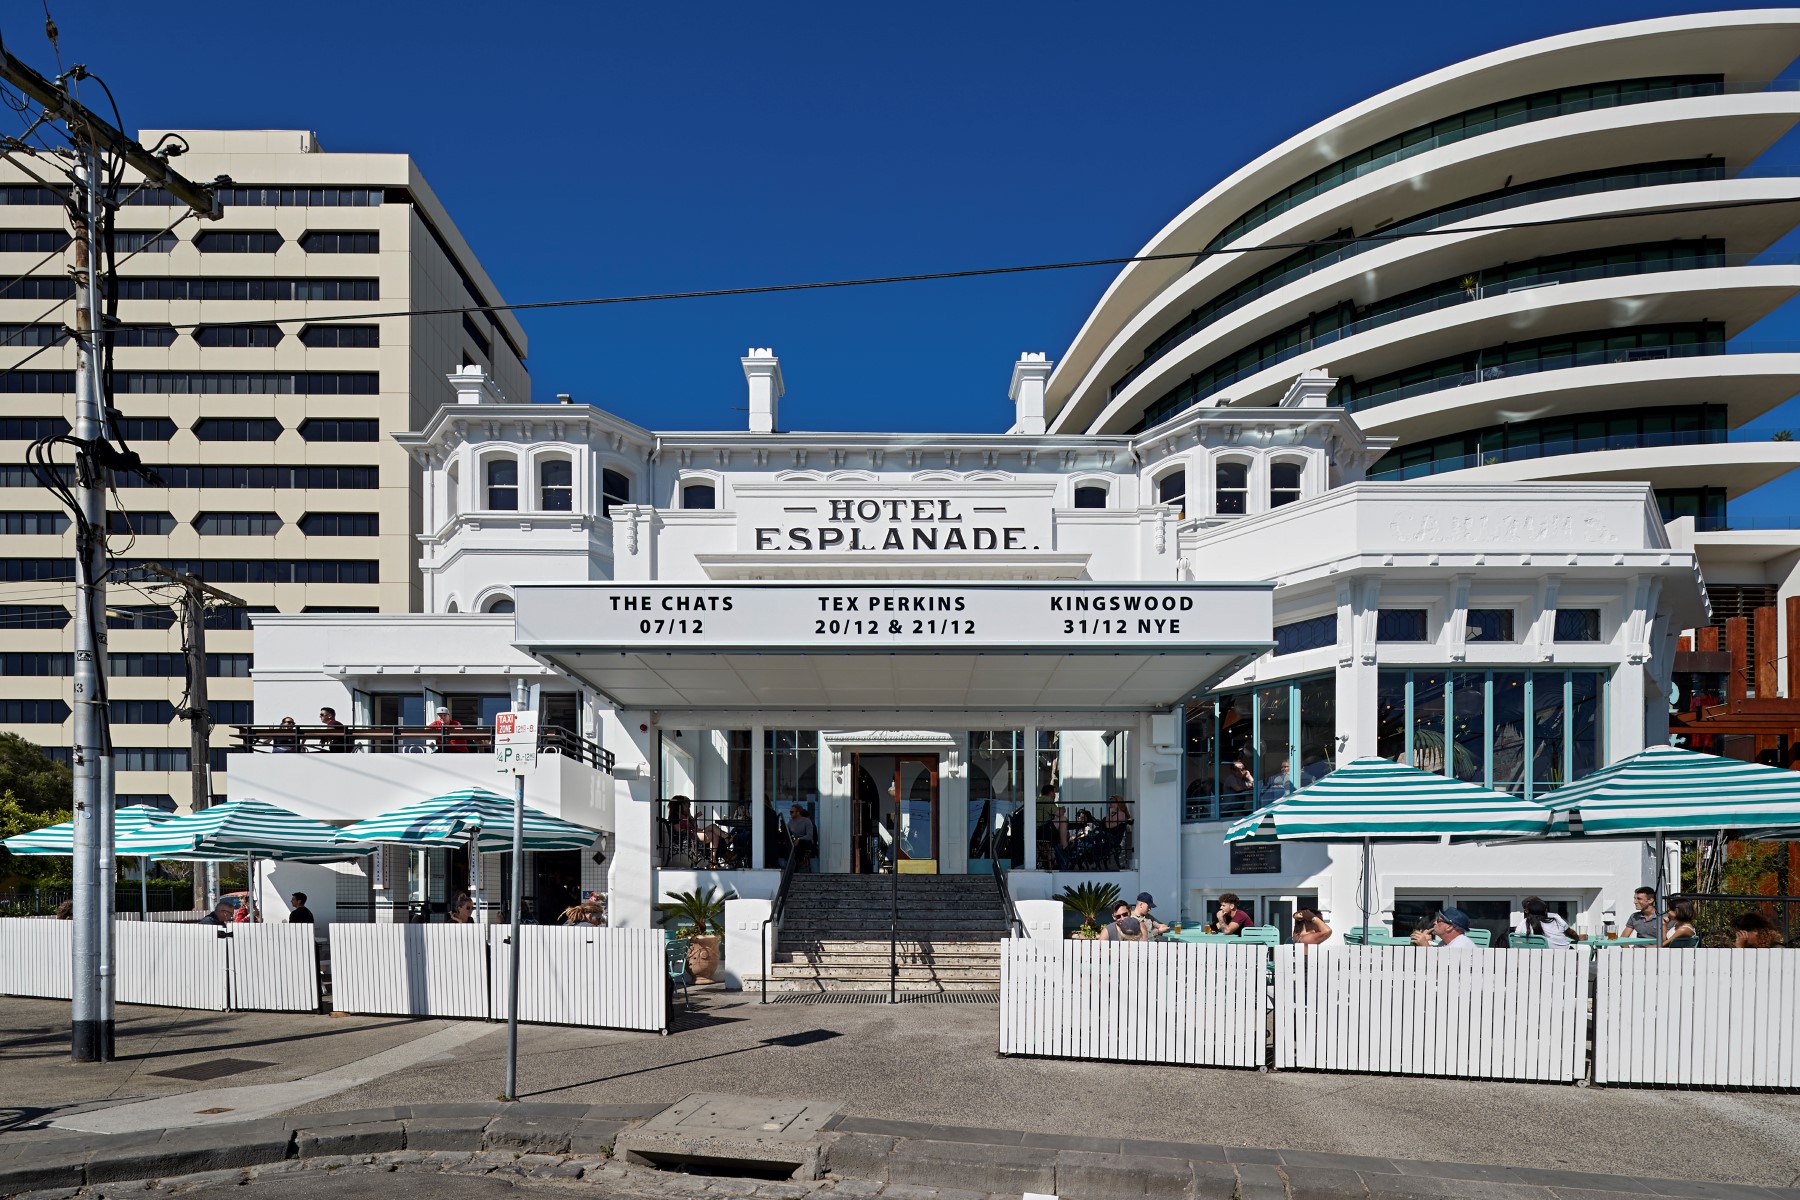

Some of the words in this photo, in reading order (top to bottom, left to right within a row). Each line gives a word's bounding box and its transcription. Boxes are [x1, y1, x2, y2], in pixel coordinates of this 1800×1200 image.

[828, 499, 962, 521] HOTEL
[754, 527, 1040, 551] ESPLANADE.
[609, 596, 652, 611] THE
[661, 596, 733, 611] CHATS
[818, 596, 859, 611] TEX
[869, 596, 965, 611] PERKINS
[1050, 596, 1193, 611] KINGSWOOD
[639, 619, 703, 634] 07/12
[815, 619, 879, 635] 20/12
[888, 619, 903, 634] &
[912, 619, 975, 635] 21/12
[1063, 619, 1127, 635] 31/12
[1138, 619, 1180, 634] NYE
[499, 715, 514, 723] TAXI
[499, 725, 512, 733] ZONE
